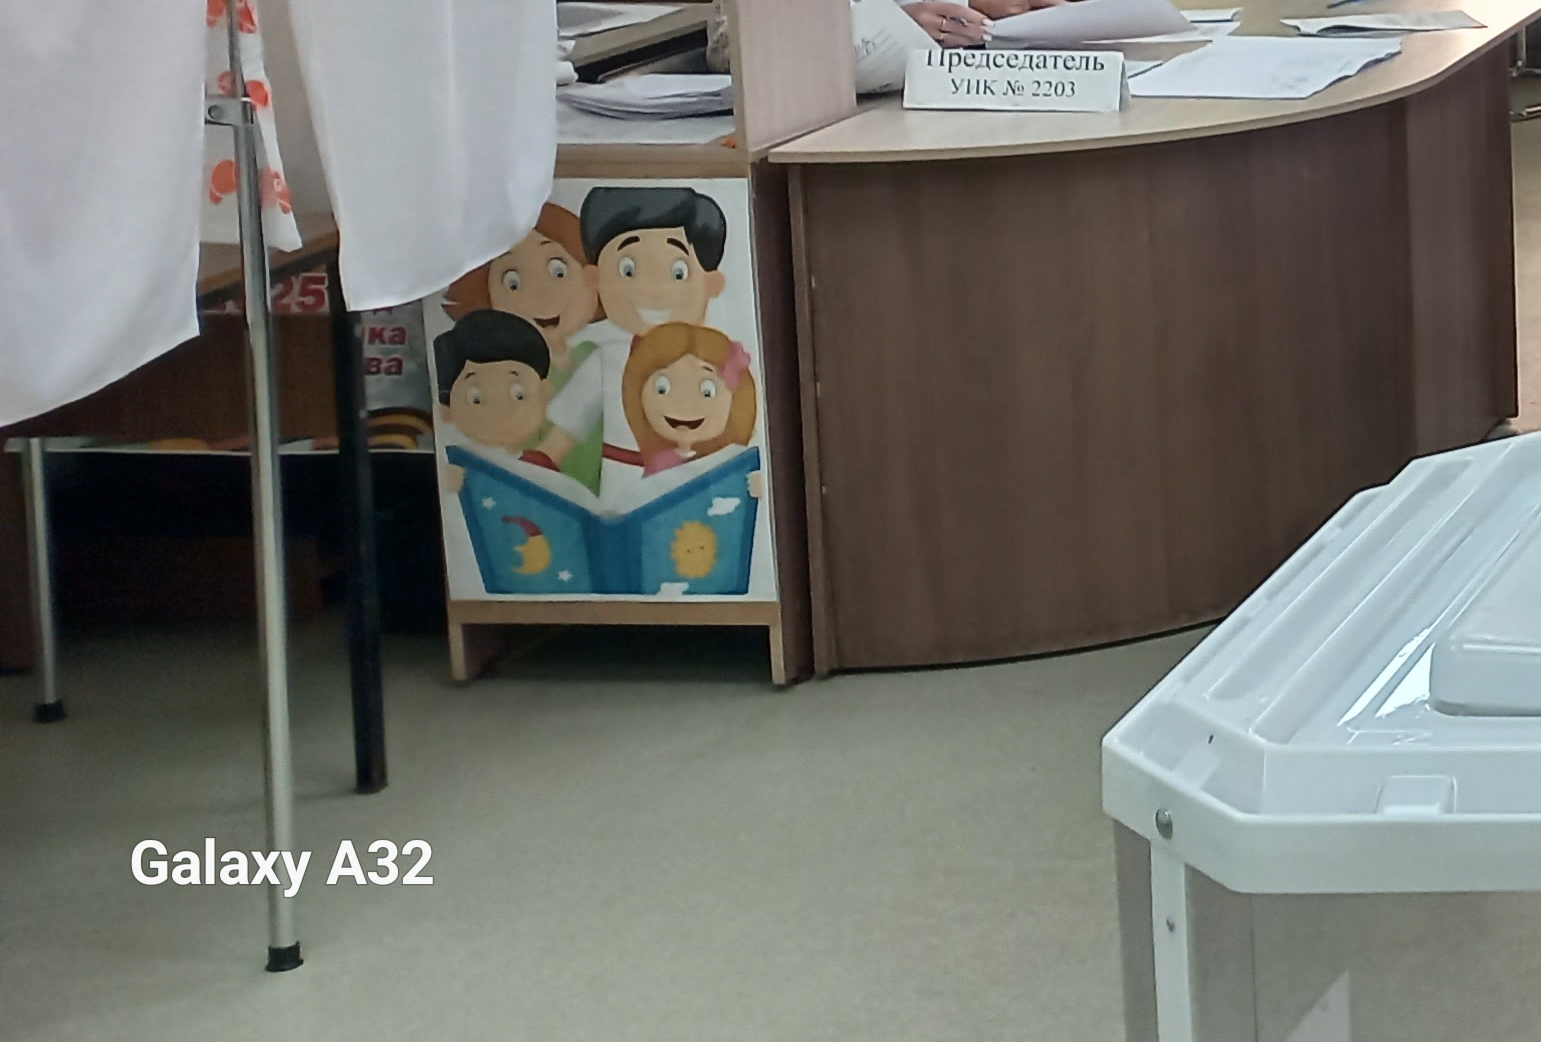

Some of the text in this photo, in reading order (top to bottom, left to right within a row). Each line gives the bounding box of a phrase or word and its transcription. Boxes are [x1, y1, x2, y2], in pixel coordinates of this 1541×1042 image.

[926, 49, 1105, 74] Председатель
[950, 77, 1077, 99] УИК № 2203
